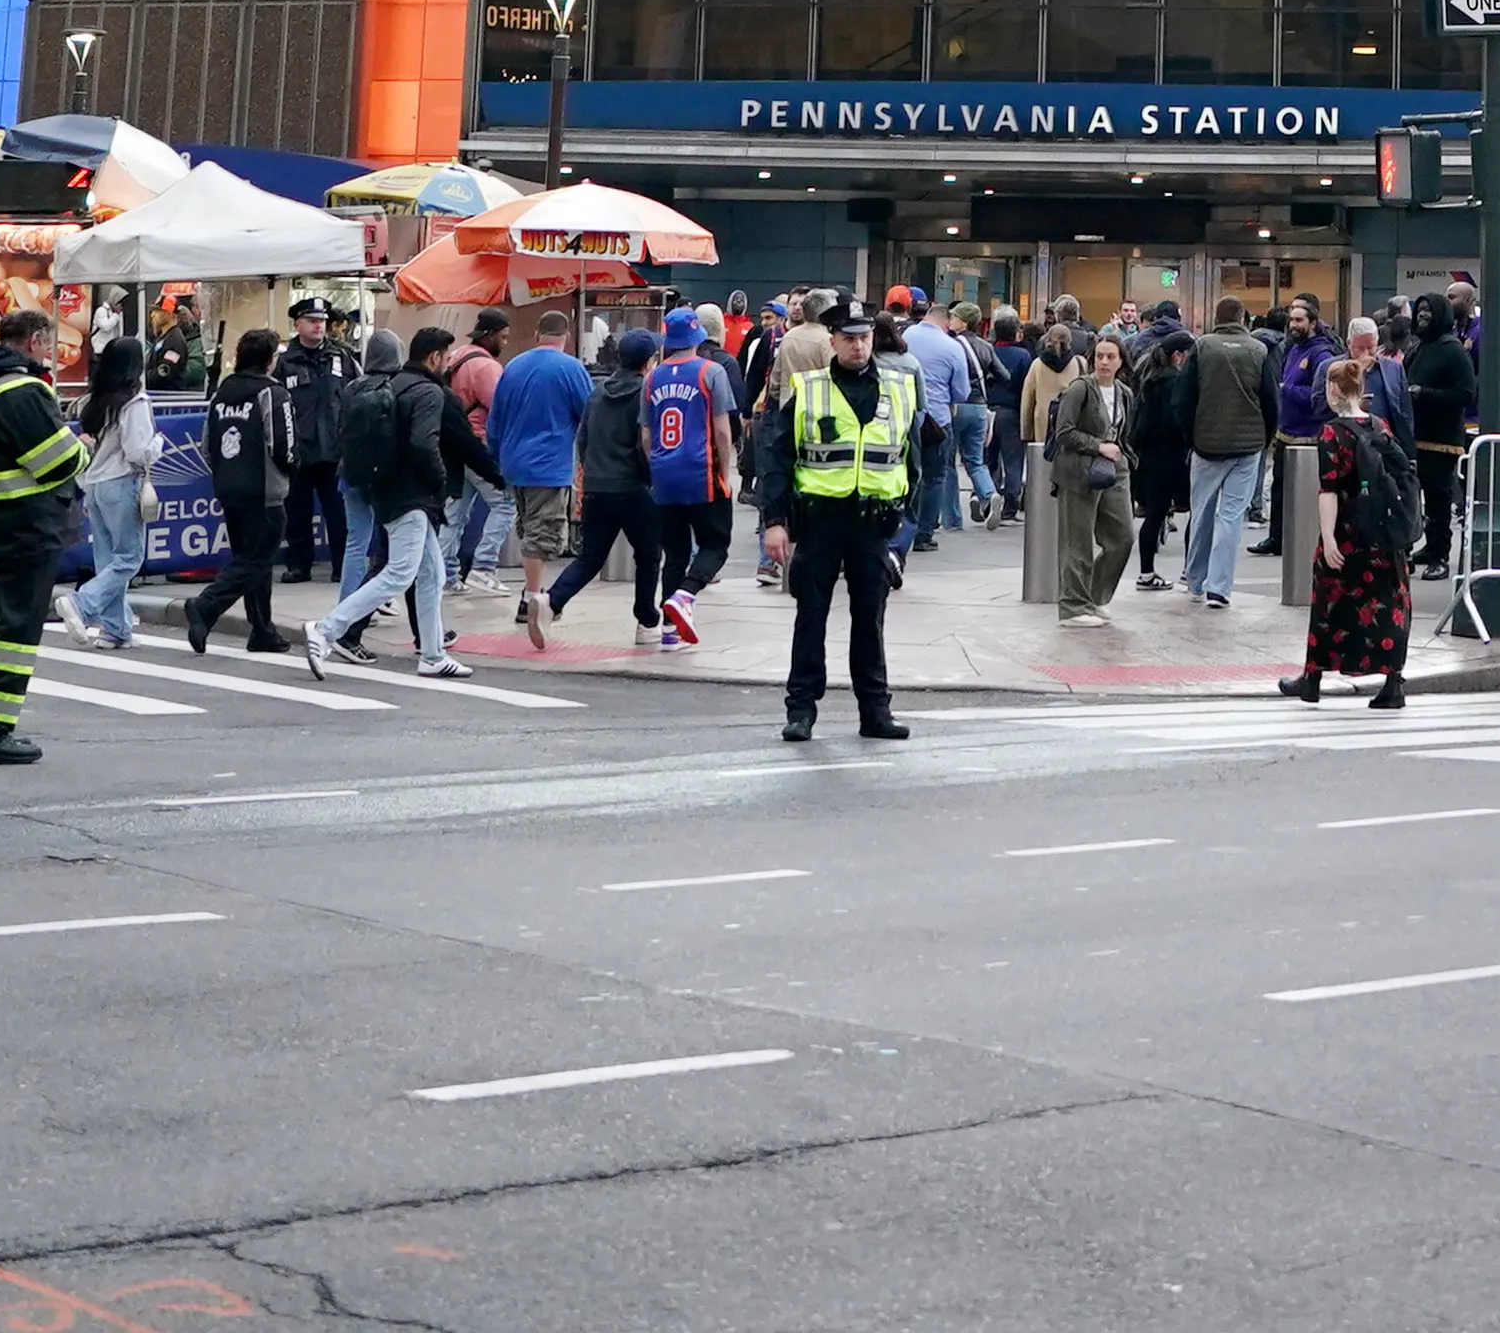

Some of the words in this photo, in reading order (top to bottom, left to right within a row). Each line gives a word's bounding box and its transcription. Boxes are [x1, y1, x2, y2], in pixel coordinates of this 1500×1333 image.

[740, 99, 1114, 136] PENNSYLVANIA
[1141, 104, 1340, 135] STATION
[215, 401, 254, 421] YALE
[659, 407, 685, 450] 8
[807, 449, 829, 463] NY
[157, 498, 225, 522] ELCO
